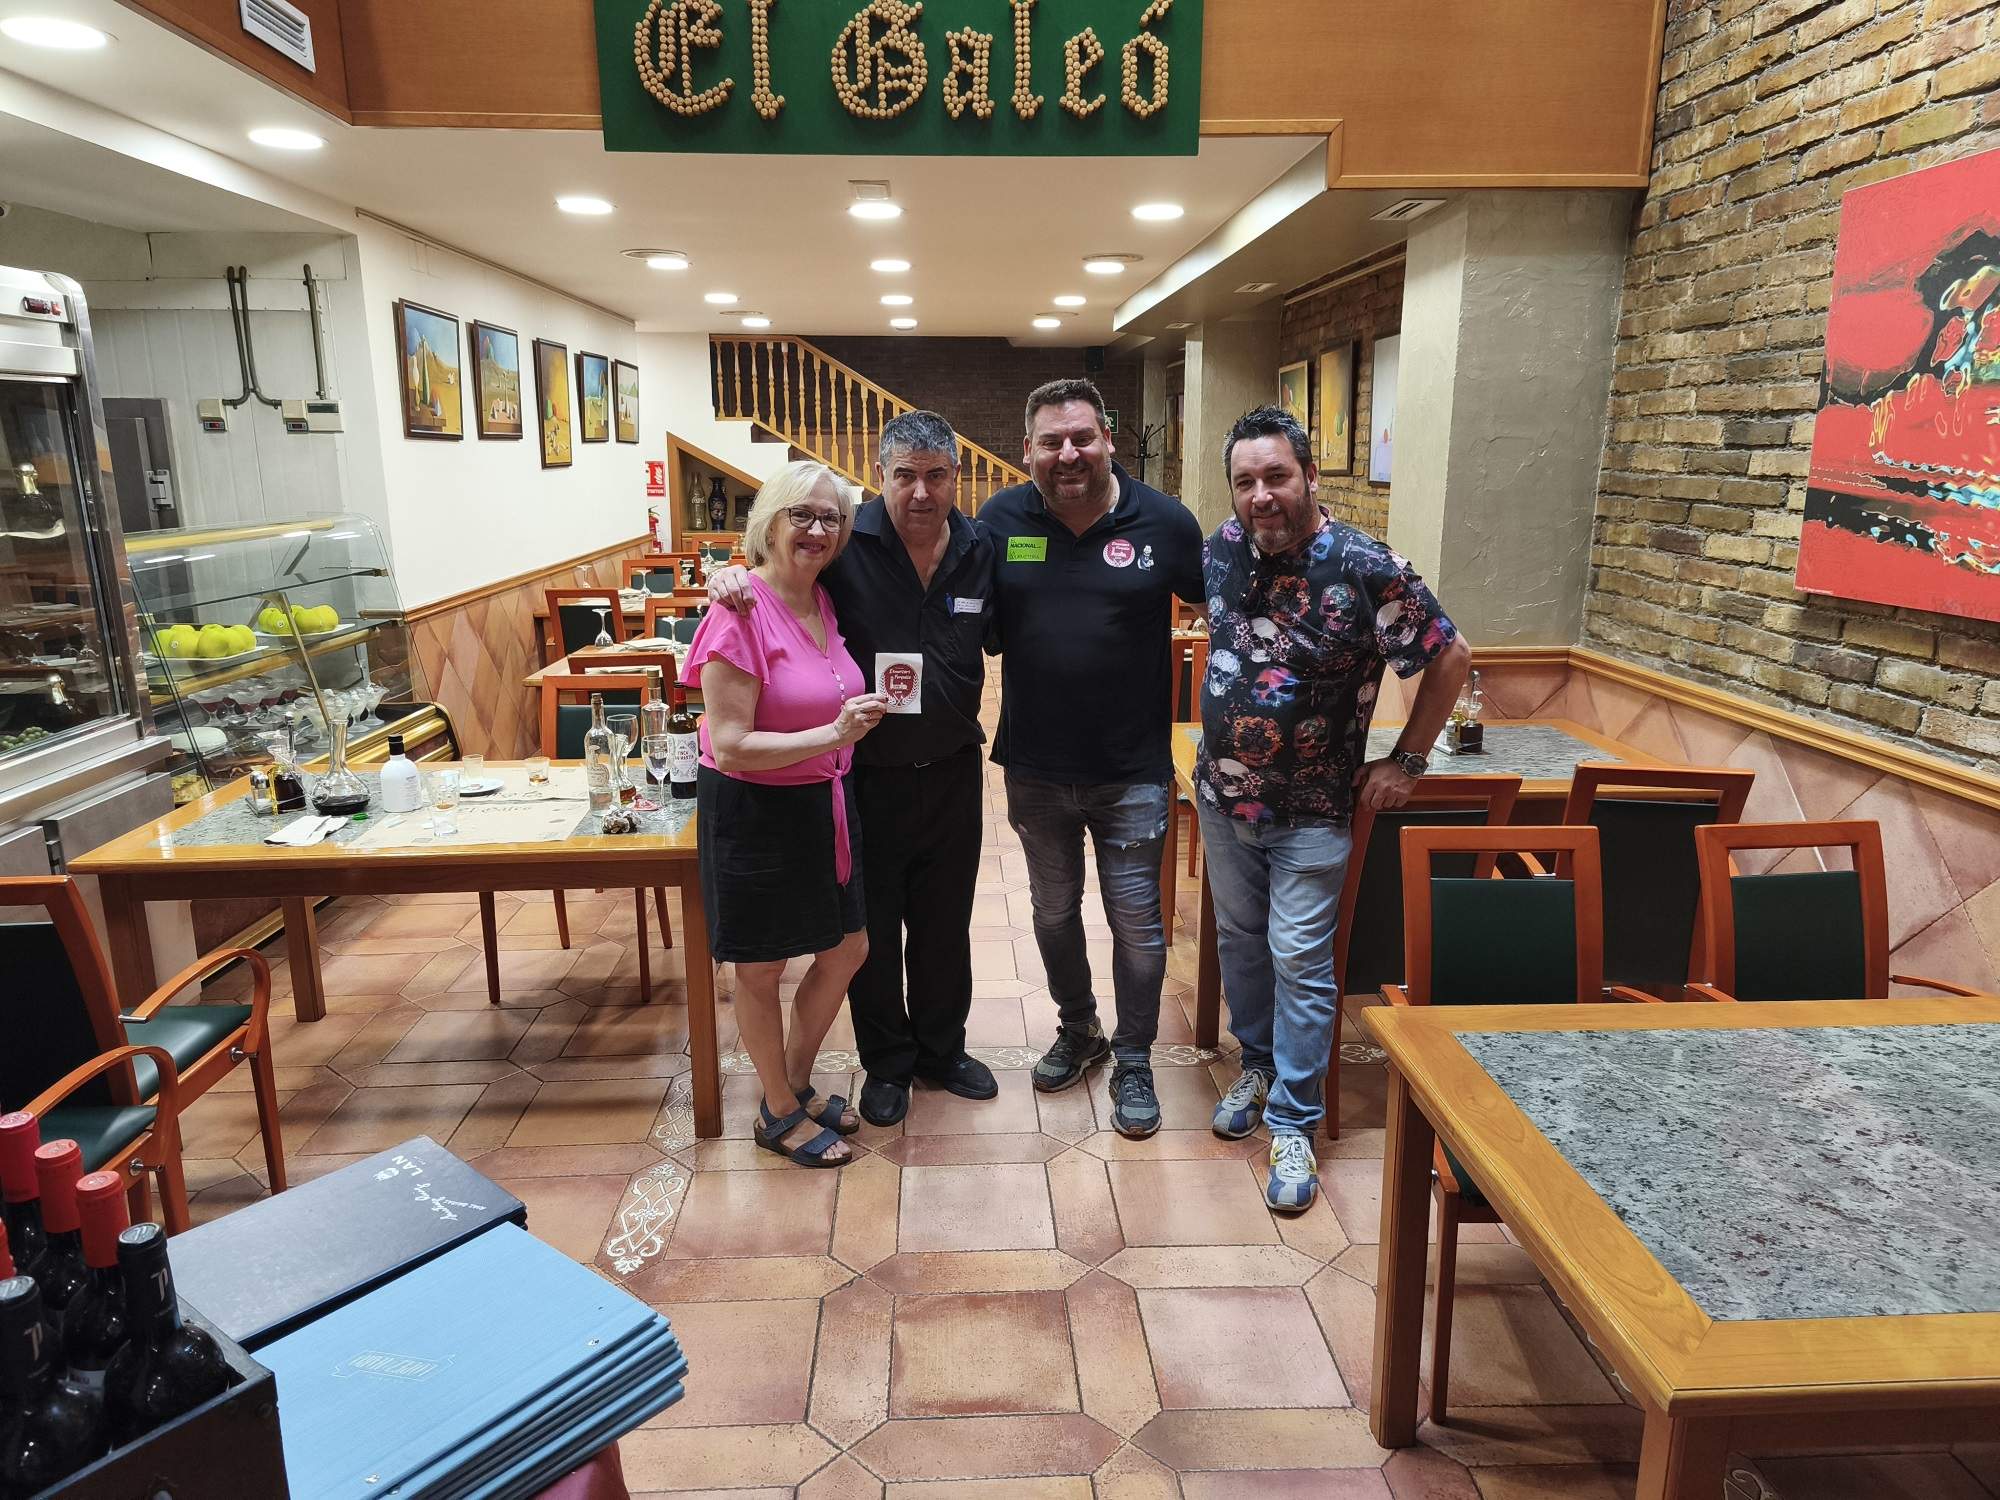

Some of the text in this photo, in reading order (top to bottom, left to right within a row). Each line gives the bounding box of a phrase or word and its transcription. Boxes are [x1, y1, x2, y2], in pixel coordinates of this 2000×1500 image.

[633, 0, 1174, 119] El Galeó
[391, 1155, 424, 1177] LAN
